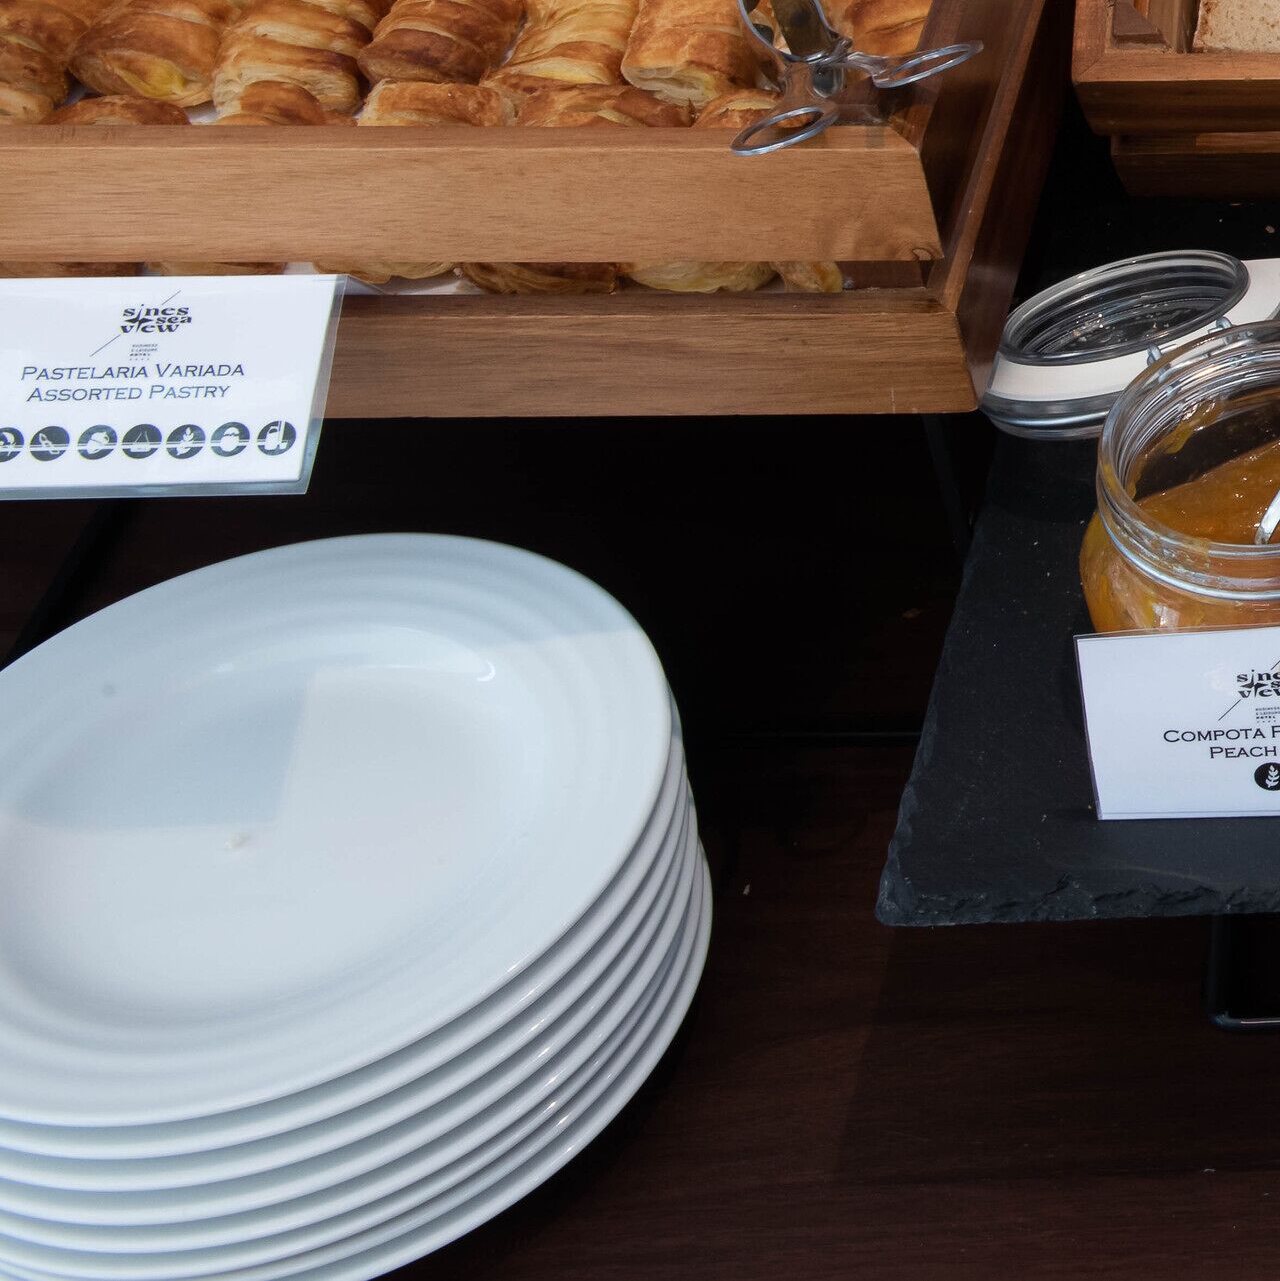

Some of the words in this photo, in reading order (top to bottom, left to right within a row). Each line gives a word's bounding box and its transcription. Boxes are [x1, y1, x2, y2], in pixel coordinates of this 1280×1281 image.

[21, 365, 149, 381] PASTELARIA
[155, 362, 245, 378] VARIADA
[26, 387, 143, 402] ASSORTED
[148, 384, 231, 399] PASTRY
[1163, 727, 1267, 743] COMPOTA
[1209, 745, 1278, 759] PEACH
